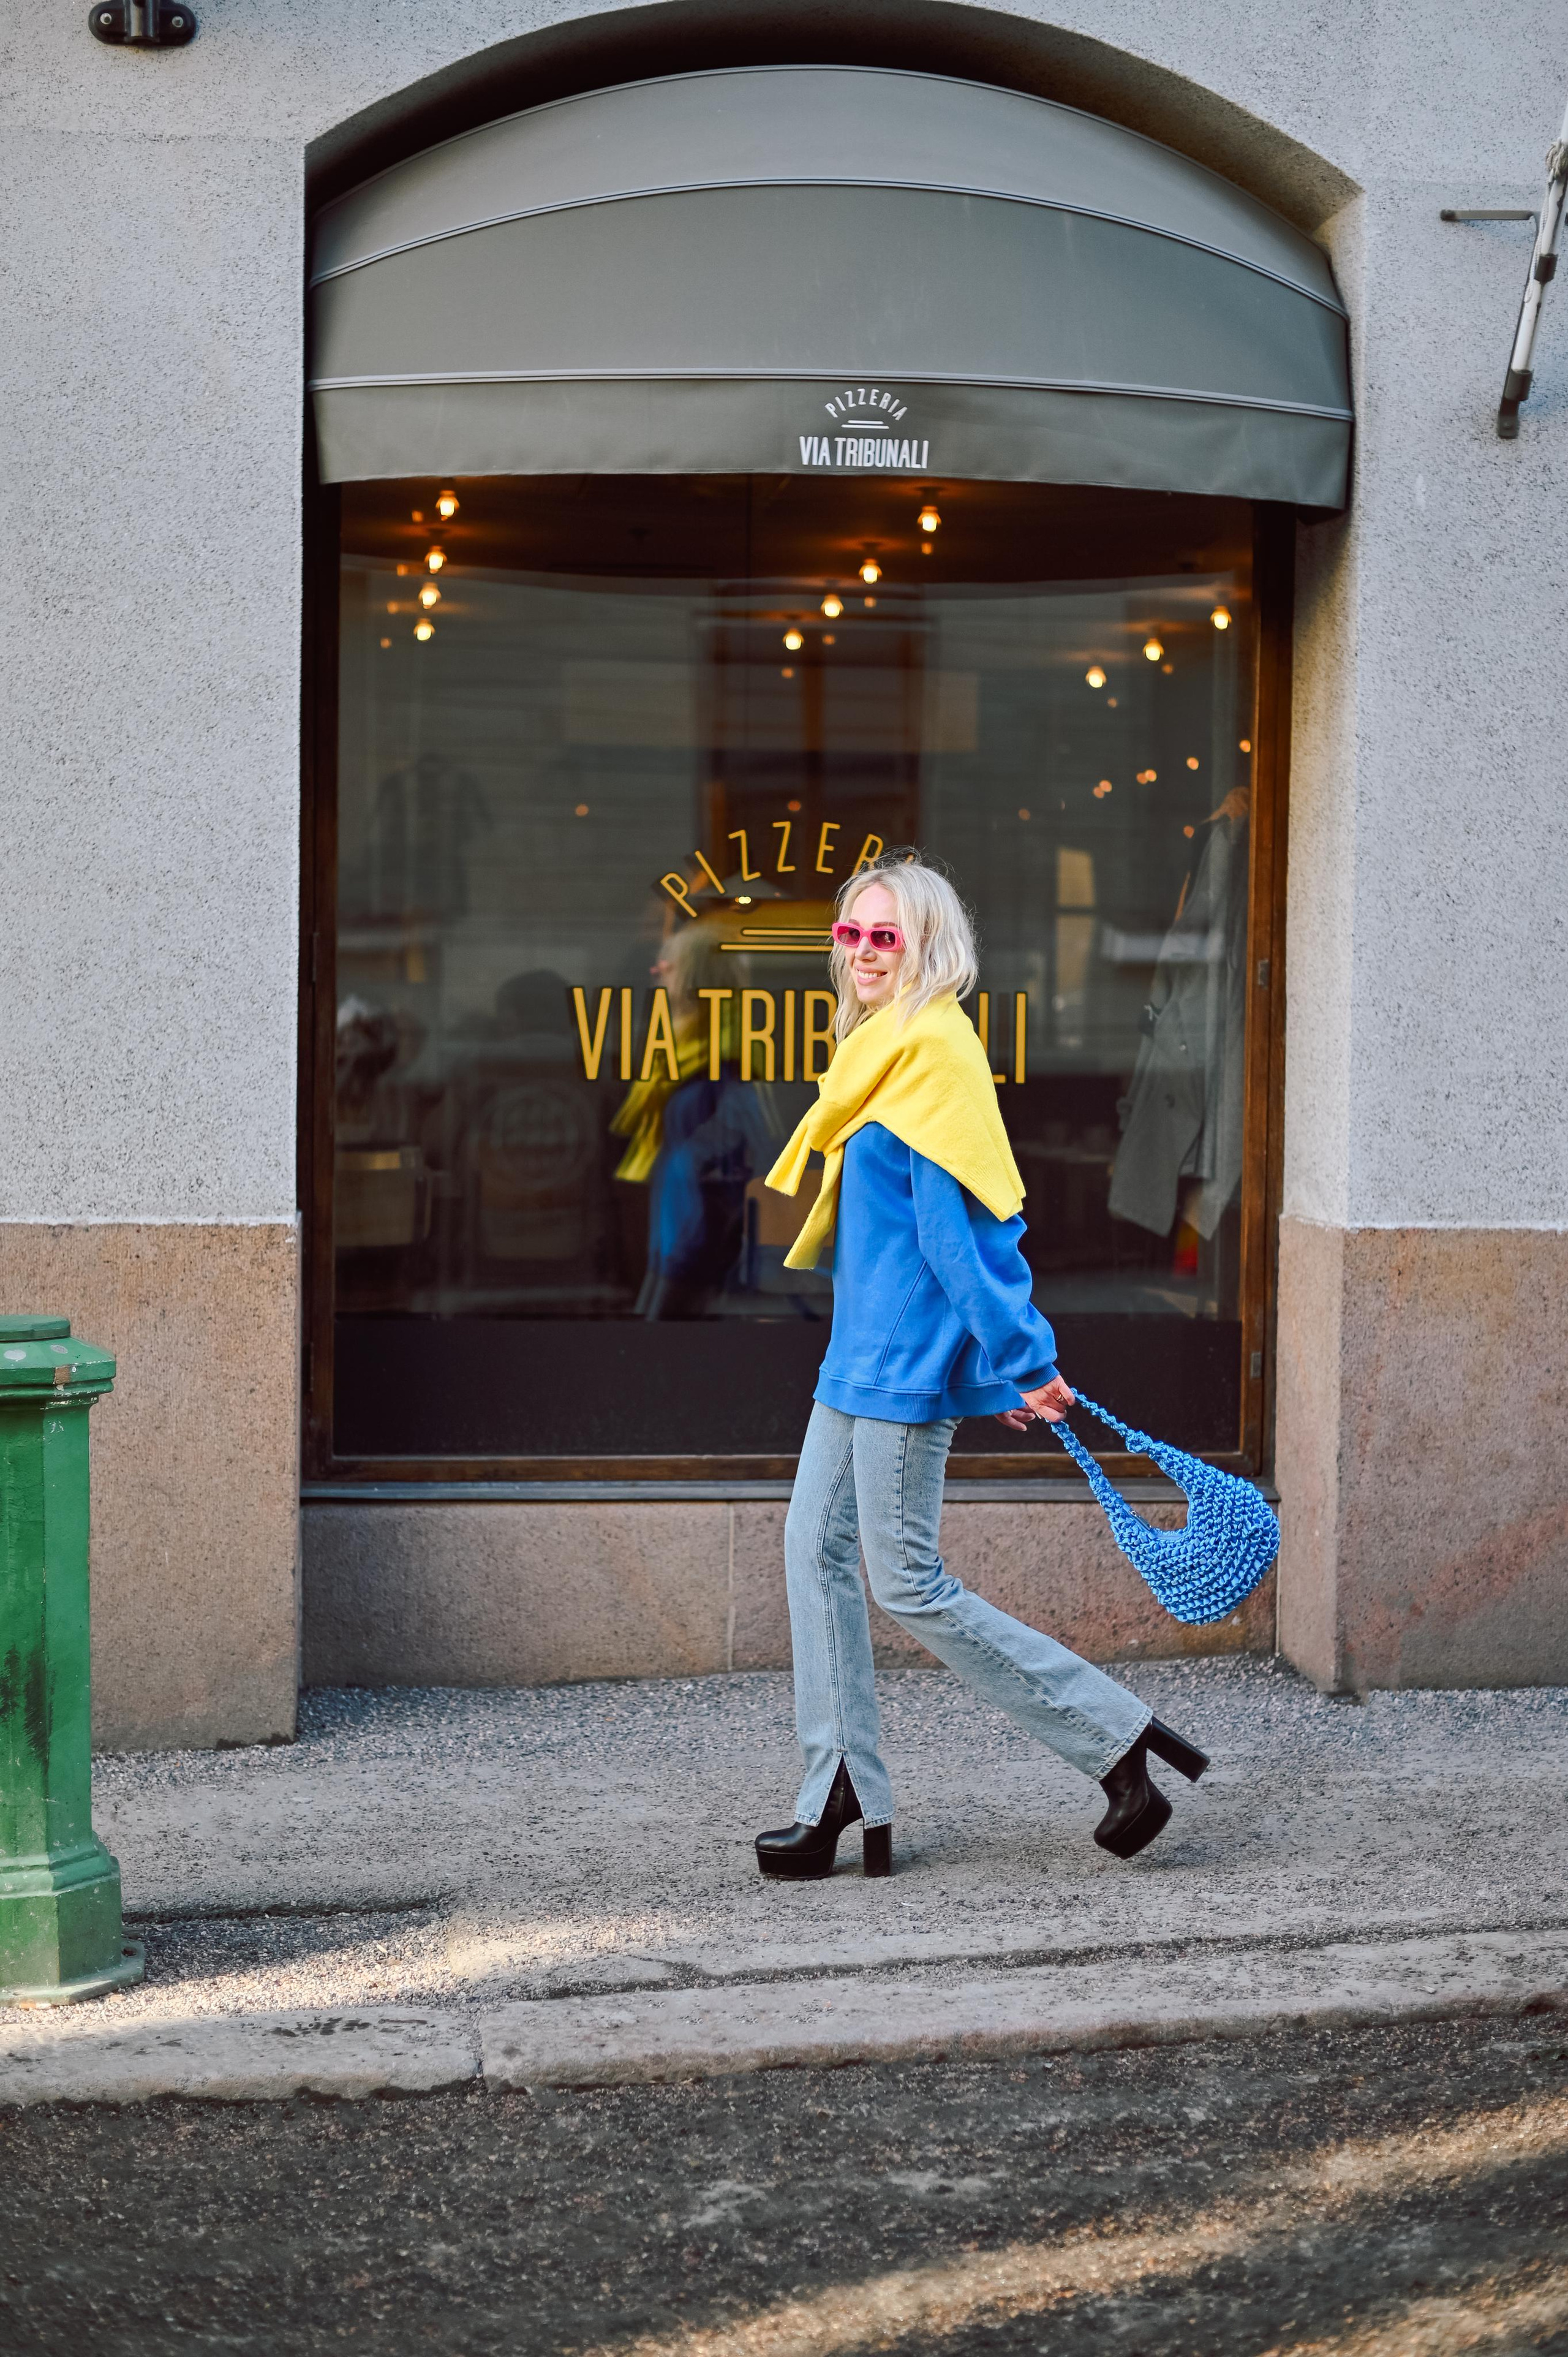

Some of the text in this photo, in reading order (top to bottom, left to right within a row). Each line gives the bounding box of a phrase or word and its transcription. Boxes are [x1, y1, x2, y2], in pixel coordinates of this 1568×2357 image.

[824, 388, 908, 420] PIZZERIA
[799, 436, 929, 469] VIA TRIBUNALI
[660, 821, 914, 918] PIZZER
[573, 987, 1026, 1083] VIA TRIBLI
